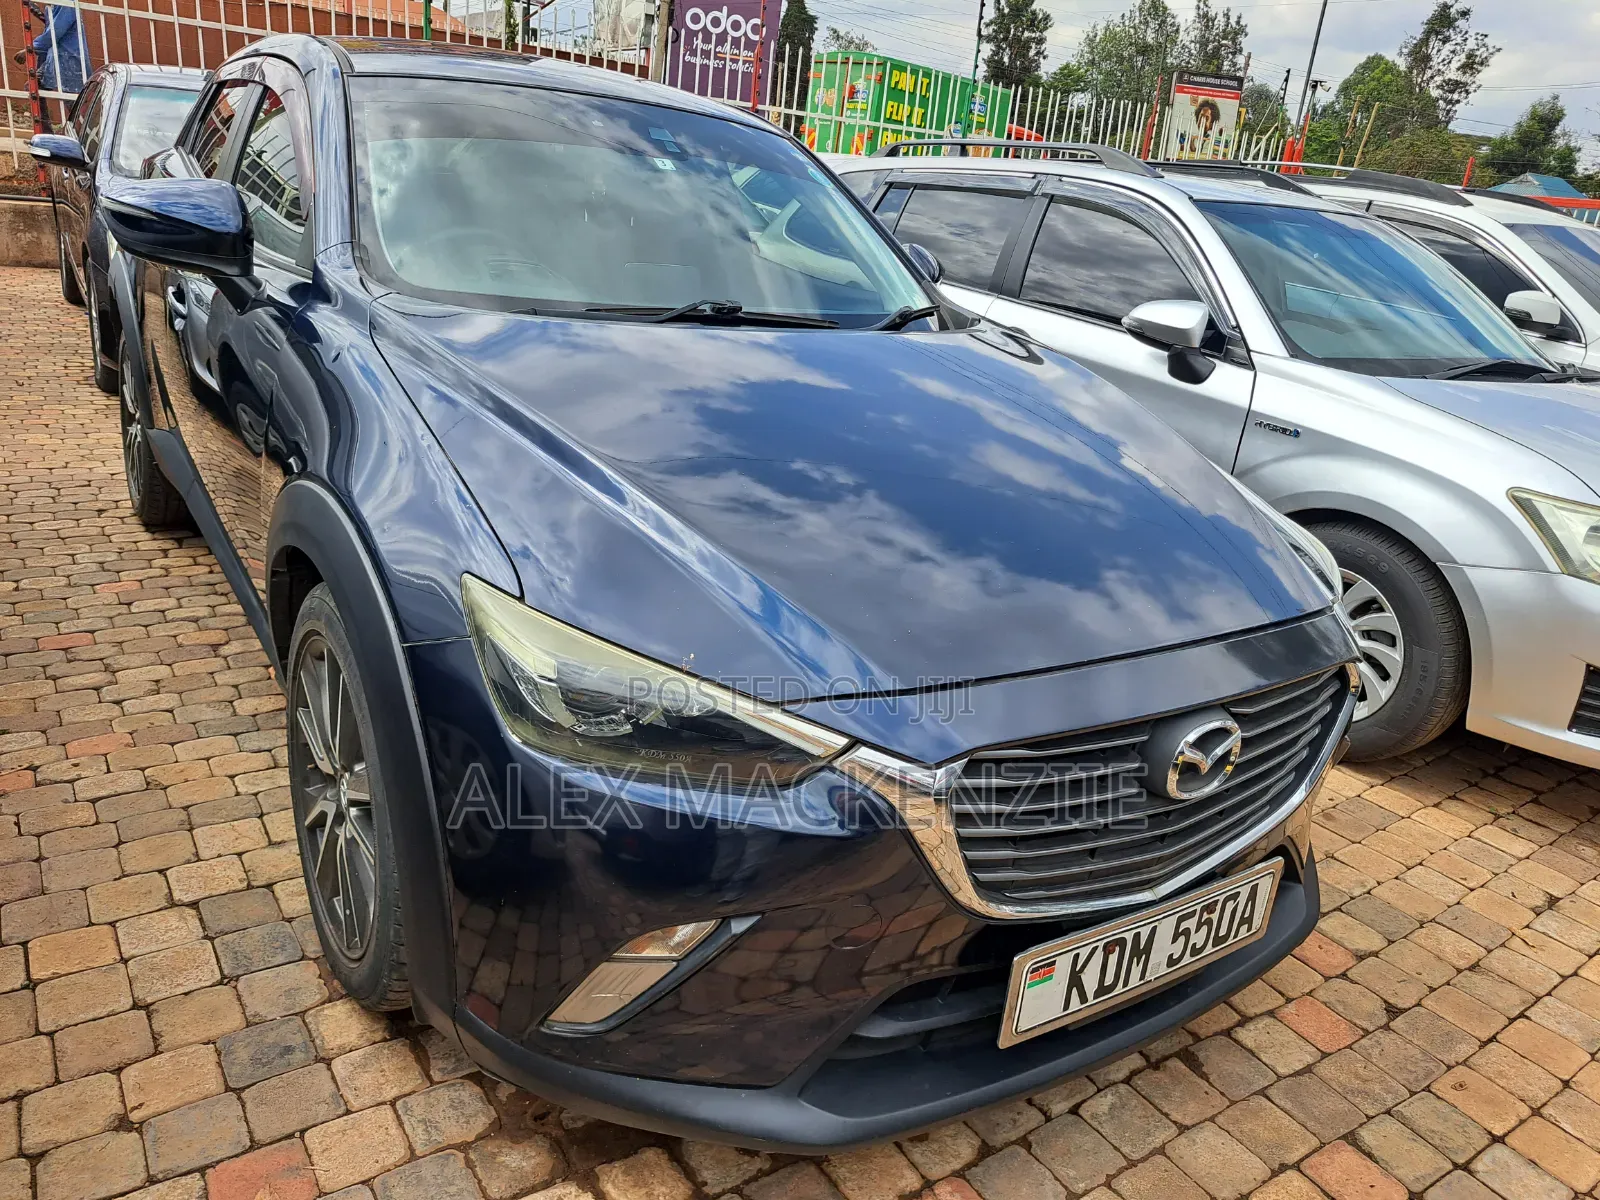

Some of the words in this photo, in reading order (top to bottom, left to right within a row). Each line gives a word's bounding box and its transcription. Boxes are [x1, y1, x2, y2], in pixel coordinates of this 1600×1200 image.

[685, 6, 766, 41] odoo
[890, 70, 916, 93] PAN
[917, 76, 930, 98] T,
[886, 100, 911, 122] FLIP
[1062, 924, 1158, 1012] KDM
[1166, 882, 1260, 969] 550A
